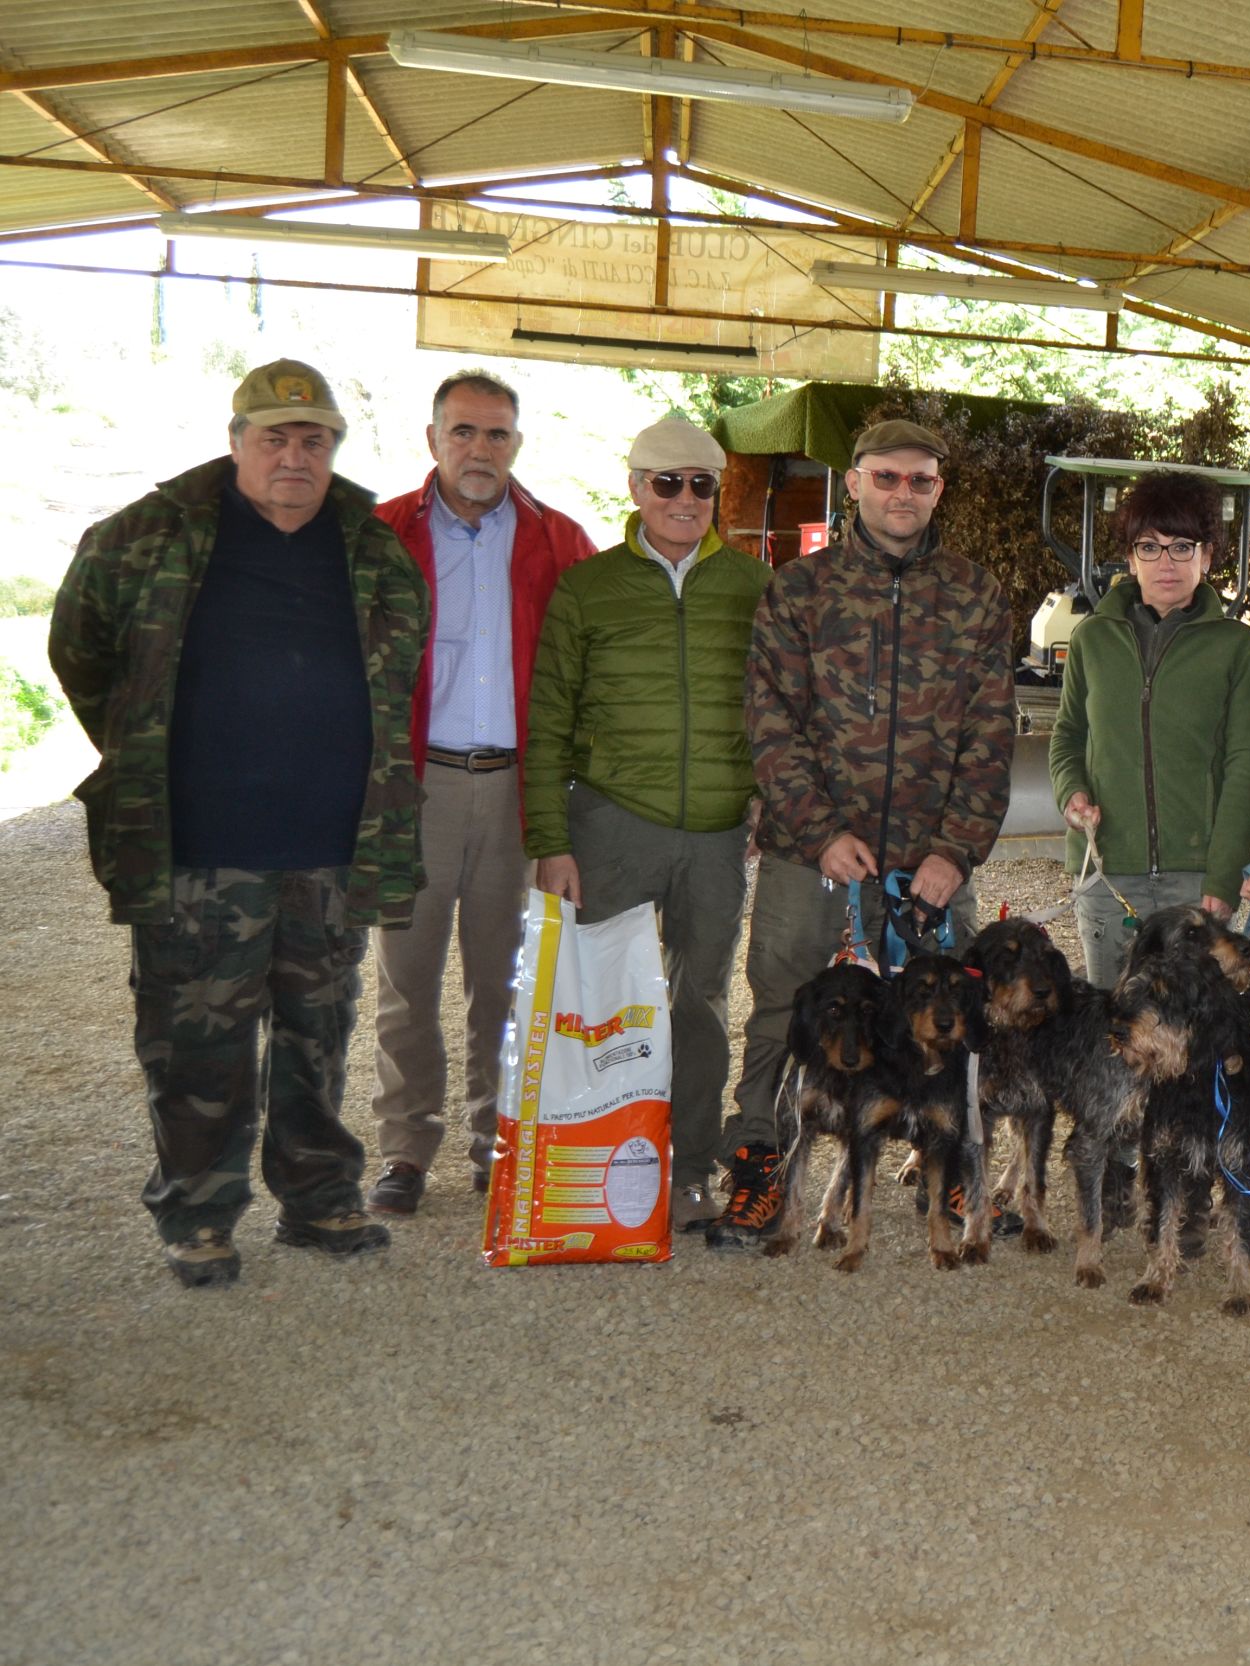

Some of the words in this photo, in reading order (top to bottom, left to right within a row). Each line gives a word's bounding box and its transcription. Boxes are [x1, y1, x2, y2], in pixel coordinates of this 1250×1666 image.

[525, 1011, 548, 1100] SYSTEM
[587, 1097, 620, 1116] NATURALE
[514, 1113, 537, 1233] NATURAL
